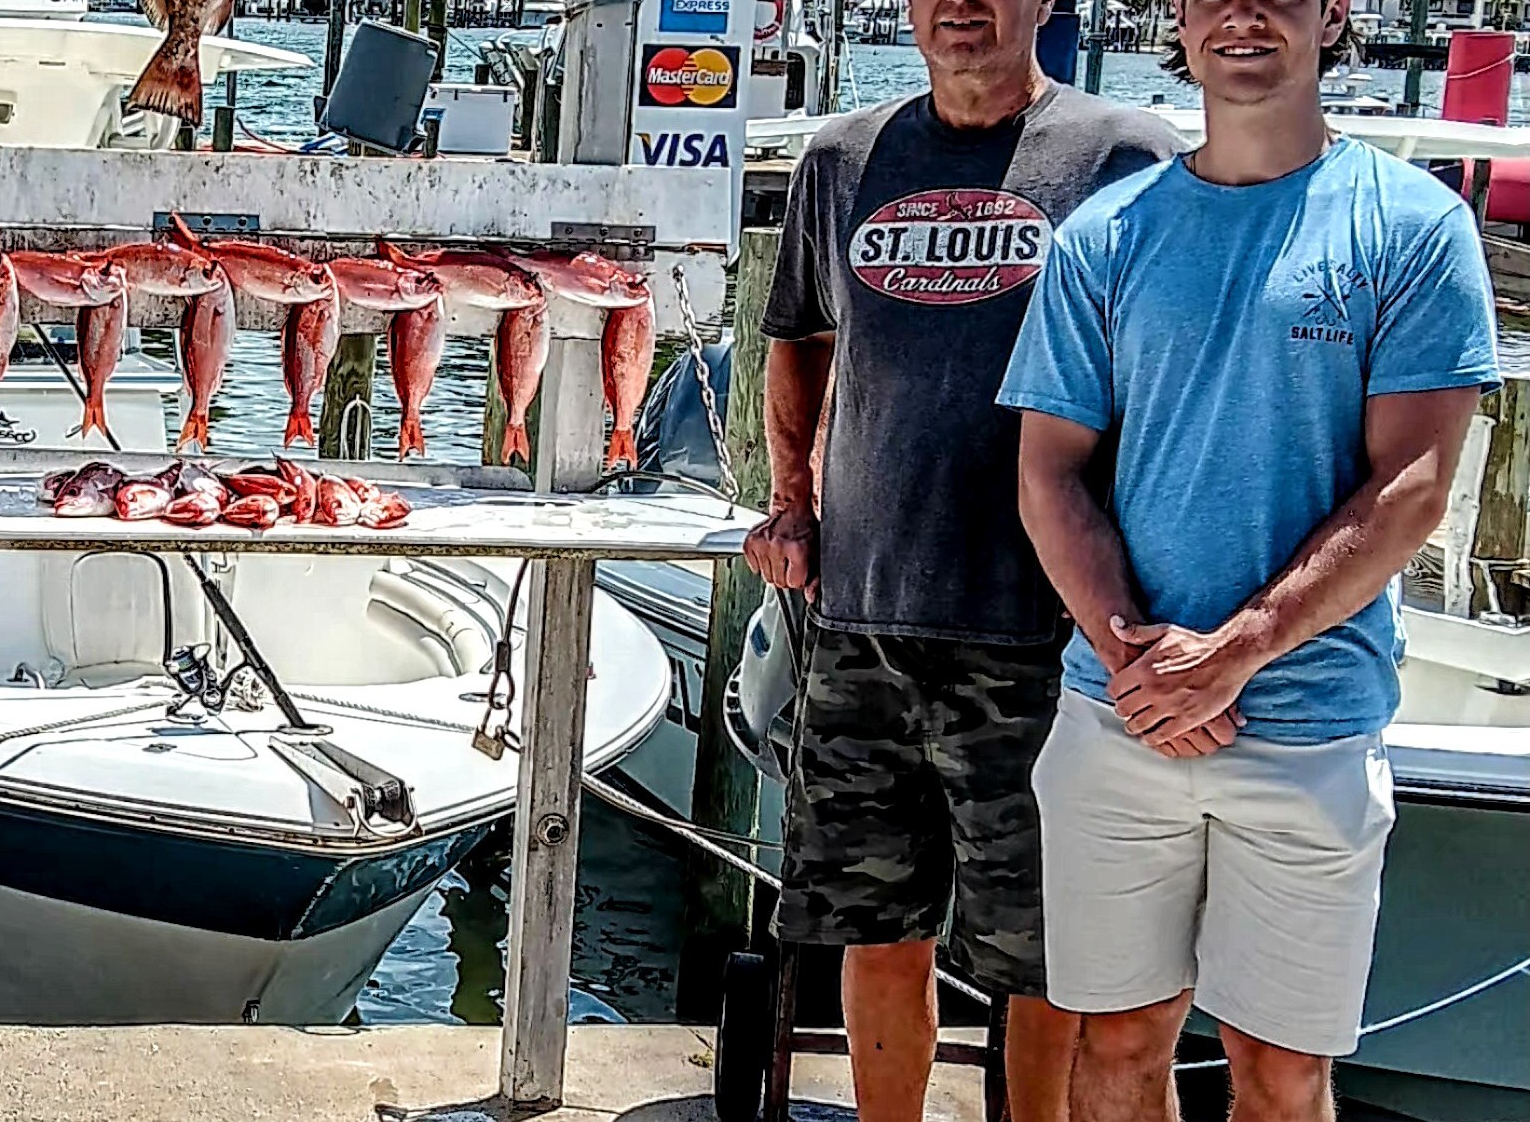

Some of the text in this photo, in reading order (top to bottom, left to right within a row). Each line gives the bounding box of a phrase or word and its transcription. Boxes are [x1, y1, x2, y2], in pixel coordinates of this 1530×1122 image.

[674, 0, 730, 11] EXPRESS
[648, 67, 731, 86] MasterCard
[636, 133, 730, 168] VISA
[897, 199, 1016, 218] SINCE 1892
[860, 224, 1040, 263] ST. LOUIS
[883, 266, 1001, 292] Cardinals
[1291, 326, 1354, 345] SALT LIFE
